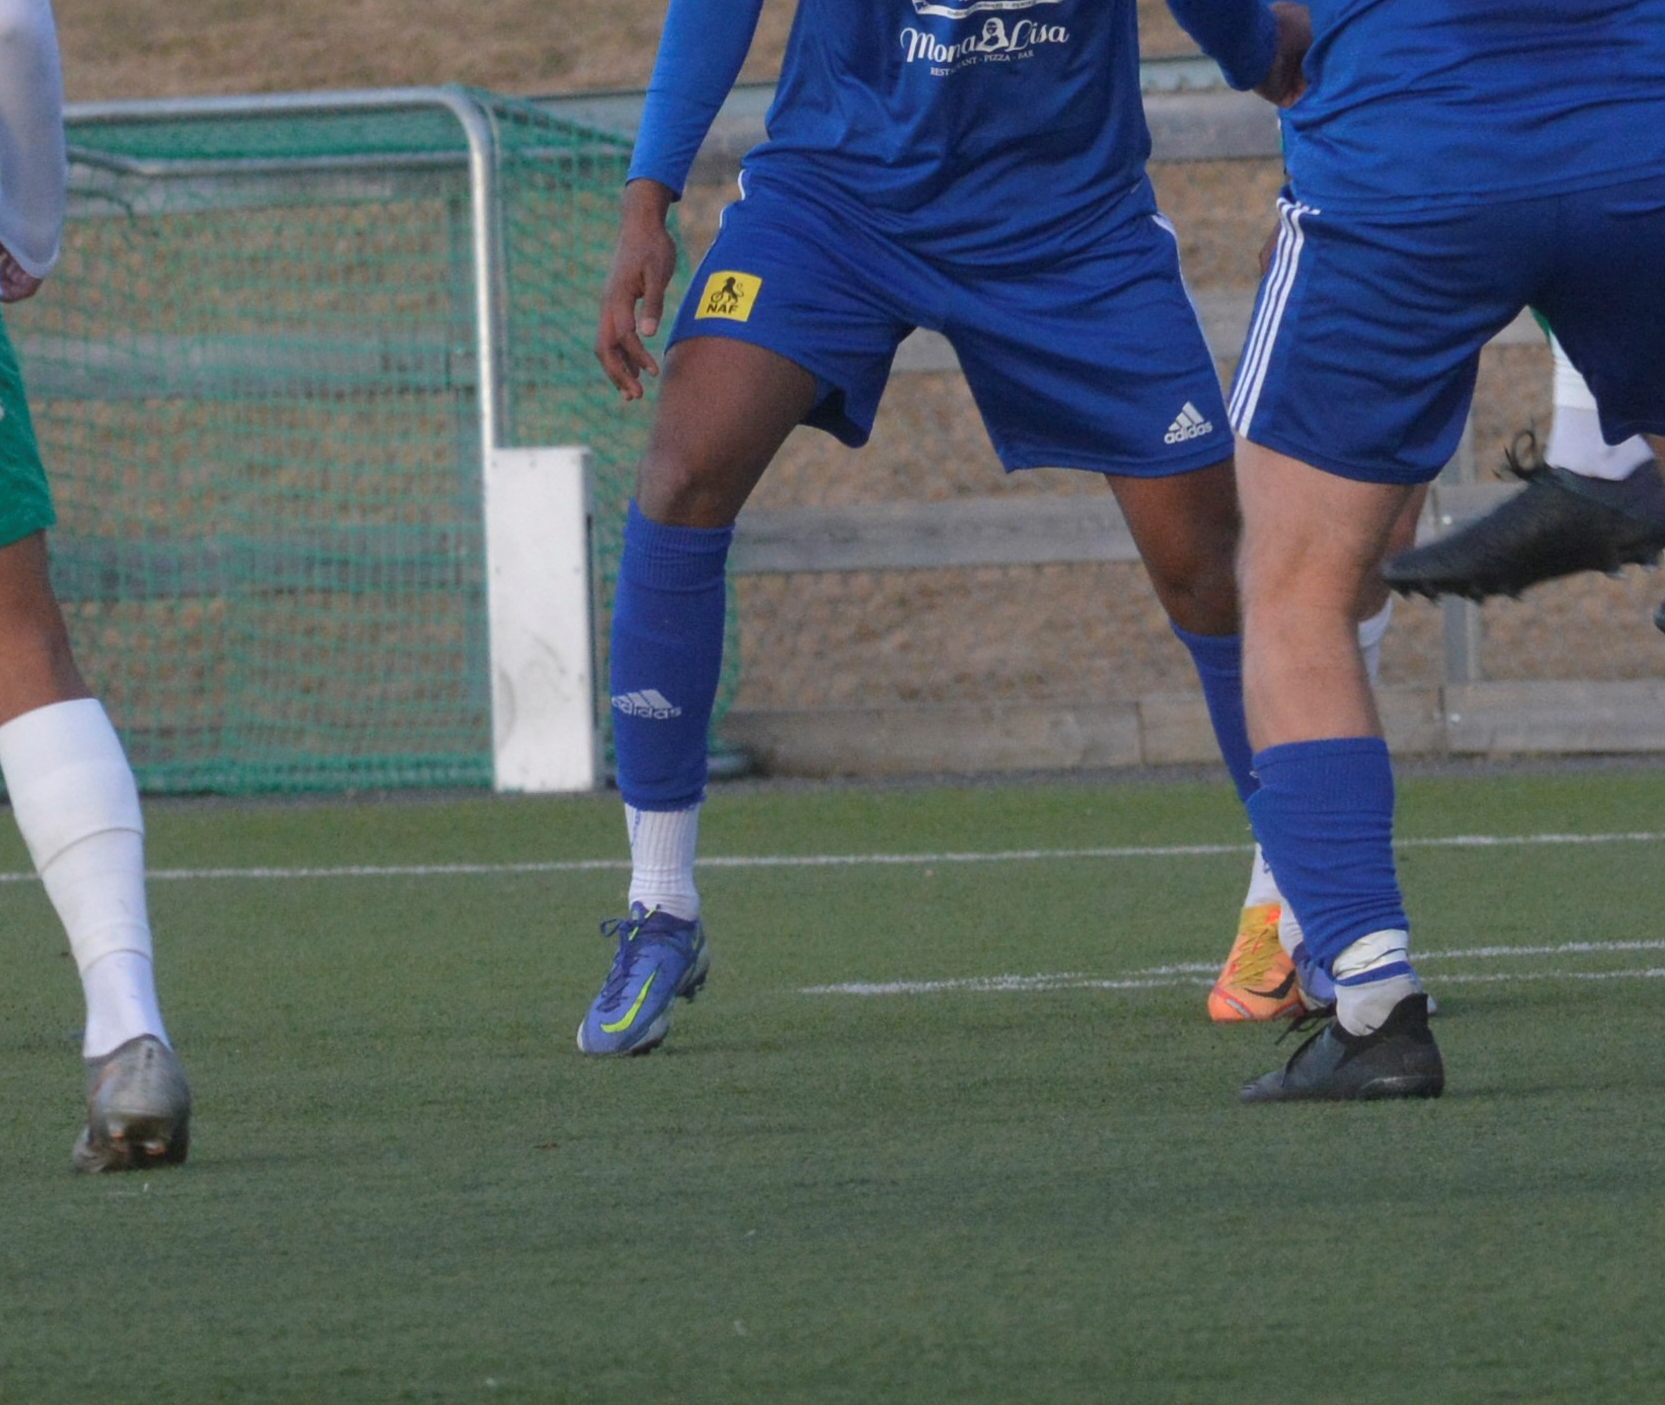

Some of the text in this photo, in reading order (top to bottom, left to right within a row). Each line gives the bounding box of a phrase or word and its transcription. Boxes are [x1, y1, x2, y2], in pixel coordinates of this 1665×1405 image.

[900, 19, 1070, 63] Mona Lisa
[984, 52, 1011, 63] PIZZA
[706, 304, 739, 315] NAF
[1164, 421, 1213, 445] adidas
[611, 696, 682, 719] adidas
